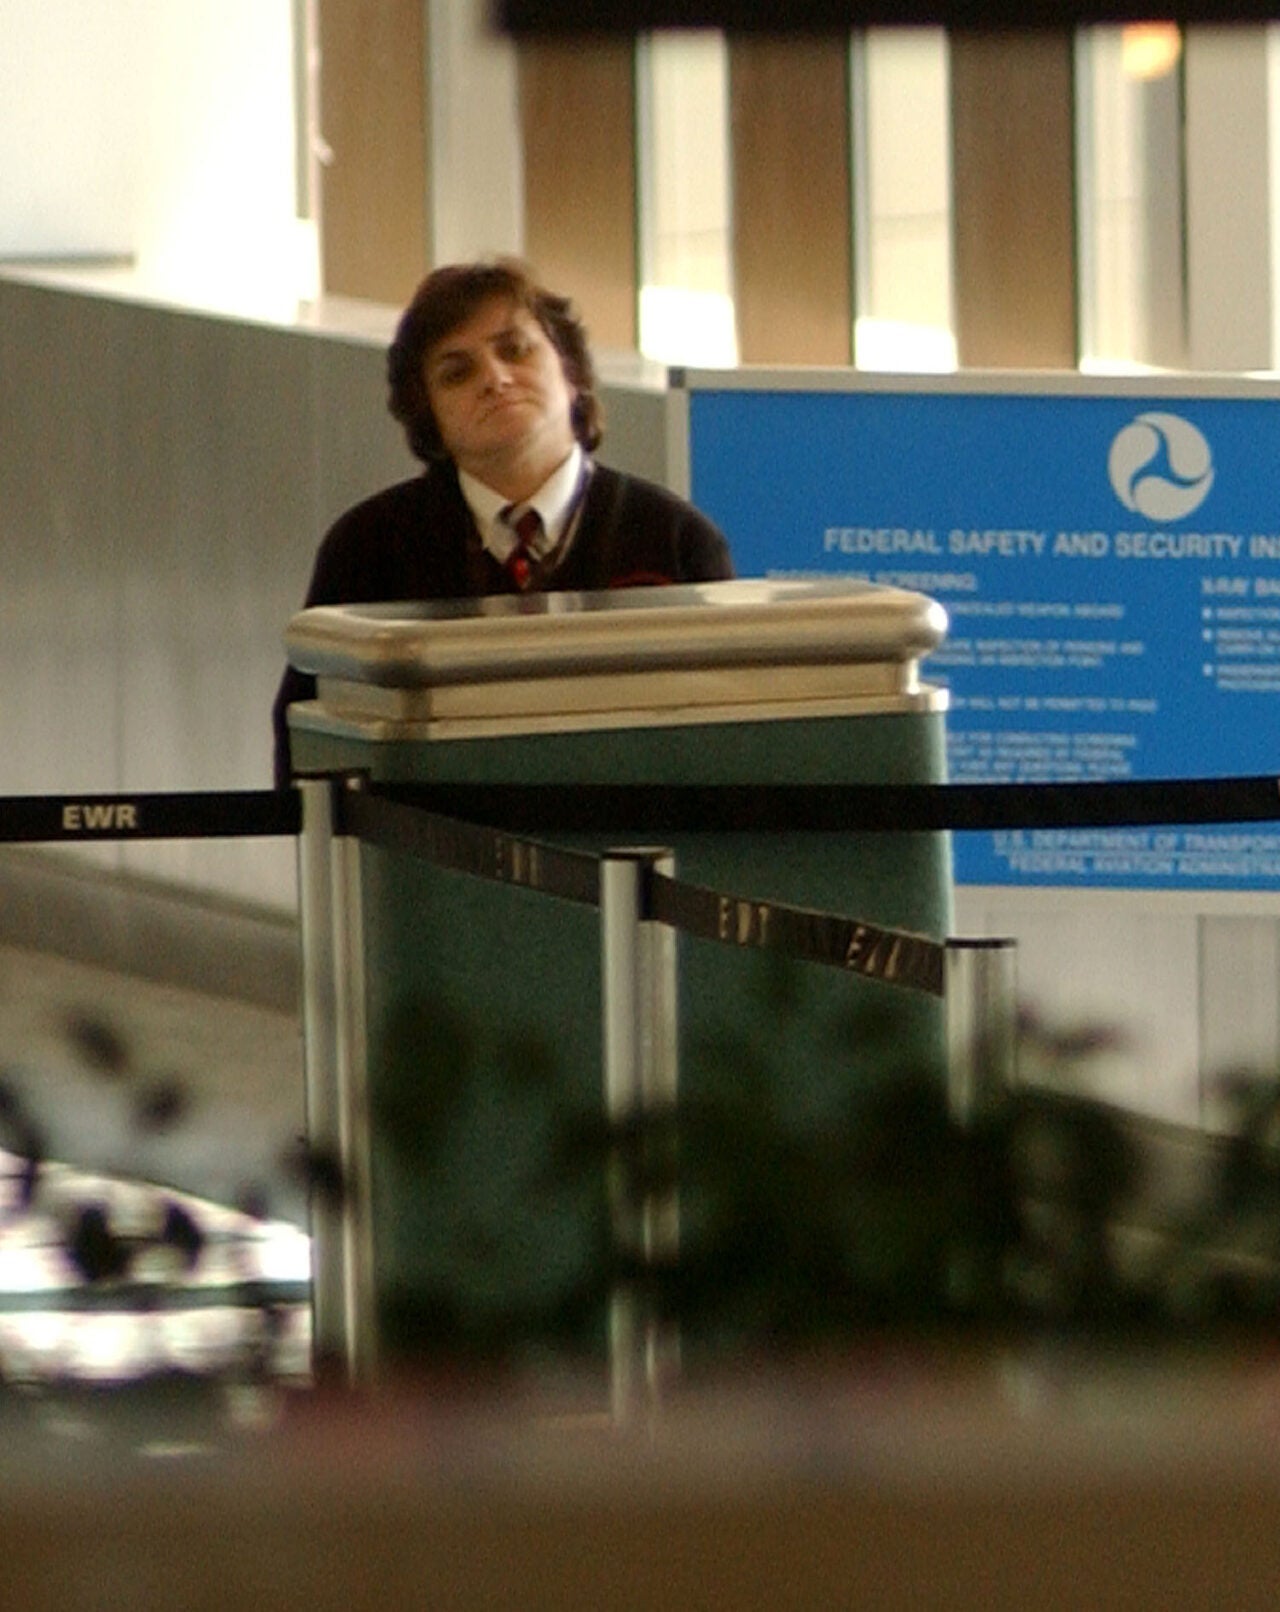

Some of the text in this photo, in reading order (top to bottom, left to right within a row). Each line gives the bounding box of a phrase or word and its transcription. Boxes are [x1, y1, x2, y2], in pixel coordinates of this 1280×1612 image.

[824, 528, 941, 554] FEDERAL
[948, 529, 1046, 556] SAFETY
[1053, 532, 1110, 557] AND
[1114, 533, 1242, 559] SECURITY
[62, 804, 138, 830] EWR
